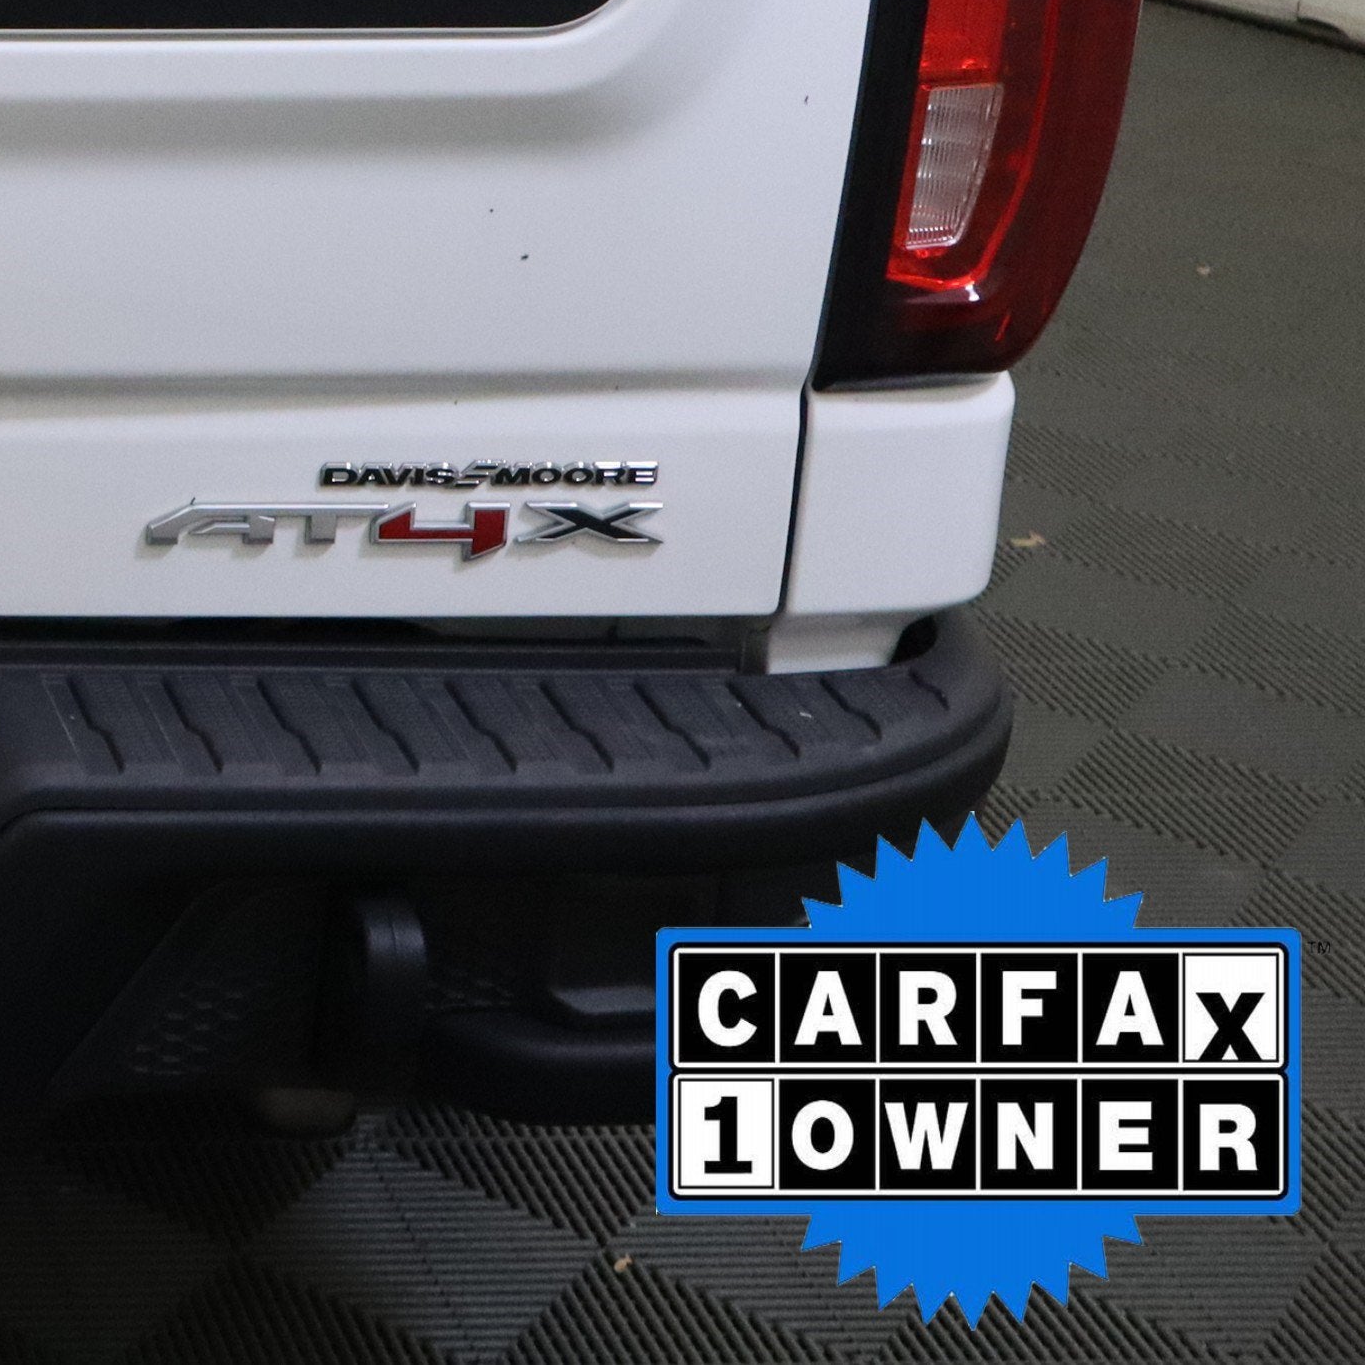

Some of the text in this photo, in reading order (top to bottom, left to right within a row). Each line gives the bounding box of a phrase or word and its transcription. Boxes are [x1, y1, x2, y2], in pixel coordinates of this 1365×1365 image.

[319, 461, 658, 486] DAVIS MOORE
[145, 500, 664, 562] AT4X
